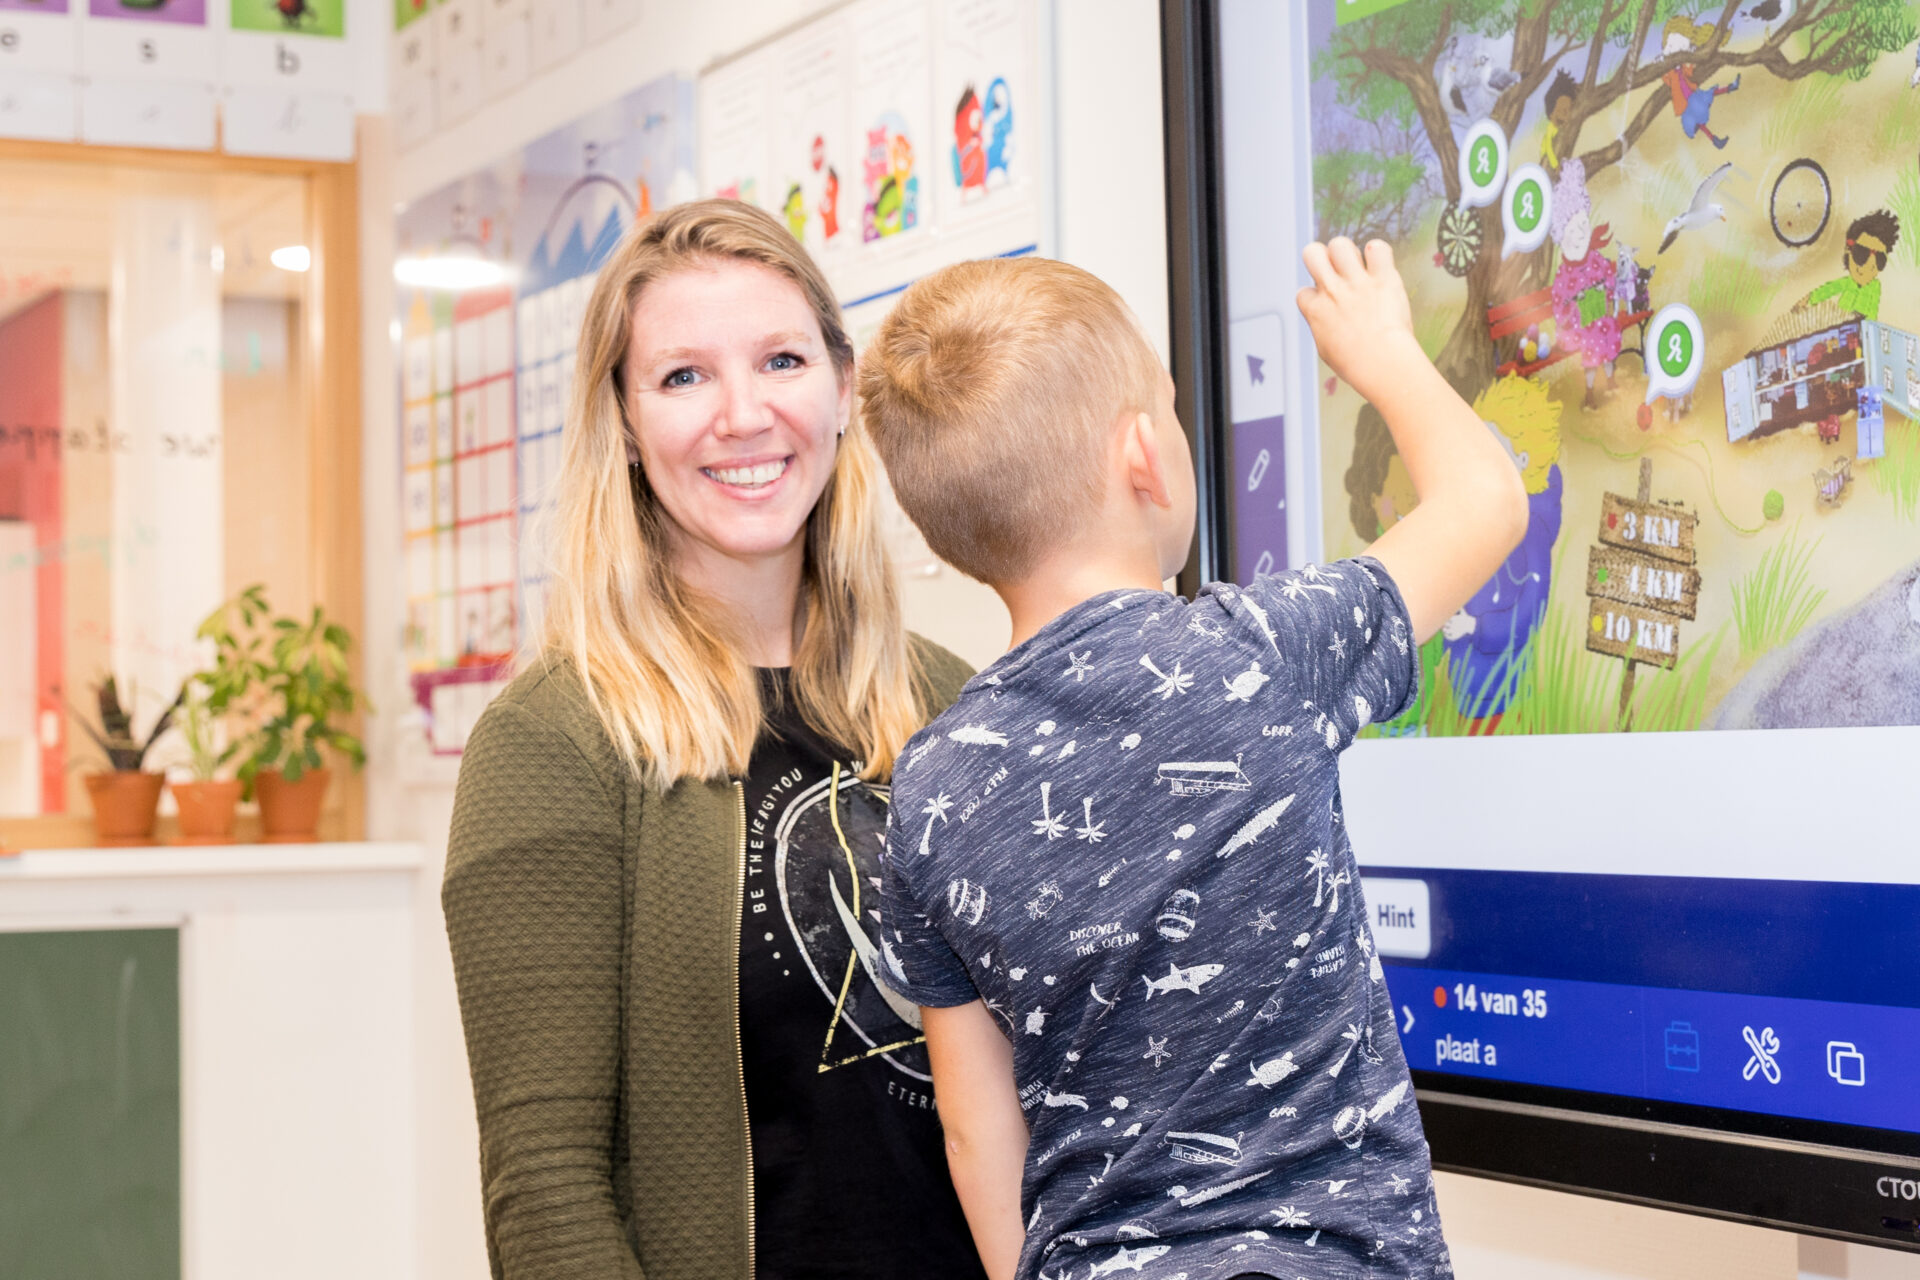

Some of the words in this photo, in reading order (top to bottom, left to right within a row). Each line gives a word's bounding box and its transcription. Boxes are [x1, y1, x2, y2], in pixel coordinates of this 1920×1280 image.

[274, 40, 302, 76] b
[1622, 511, 1637, 541] 3
[1643, 514, 1680, 548] KM
[1646, 567, 1684, 601] KM
[1604, 611, 1631, 643] 10
[1636, 618, 1674, 654] KM
[771, 767, 803, 794] YOU
[748, 839, 765, 876] THE
[752, 888, 768, 914] BE
[1377, 903, 1416, 929] Hint
[1069, 921, 1123, 942] DISCOVER
[1101, 931, 1141, 950] OCEAN
[1453, 982, 1479, 1012] 14
[1480, 990, 1518, 1016] van
[1522, 988, 1548, 1019] 35
[1435, 1032, 1481, 1067] plaat
[1483, 1043, 1498, 1066] a
[1876, 1175, 1920, 1201] CTO
